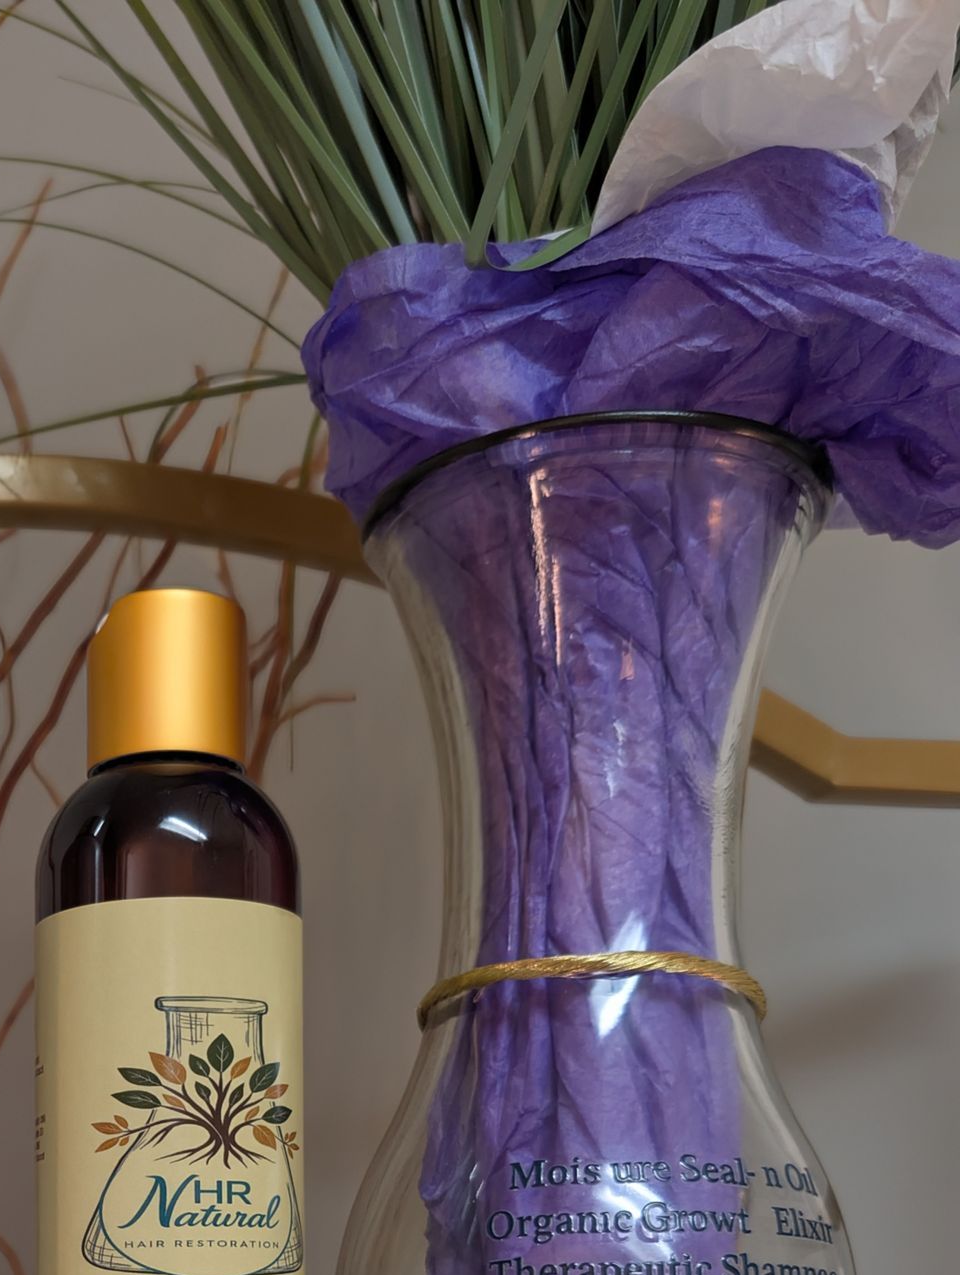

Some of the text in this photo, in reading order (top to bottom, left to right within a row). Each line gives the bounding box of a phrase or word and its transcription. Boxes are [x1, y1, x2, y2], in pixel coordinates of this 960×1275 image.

[509, 1158, 672, 1191] Moisure
[785, 1163, 818, 1196] Oil
[117, 1174, 281, 1229] Natural
[486, 1201, 834, 1245] Organic Growt Elixir
[124, 1240, 280, 1249] HAIR RESTORATION
